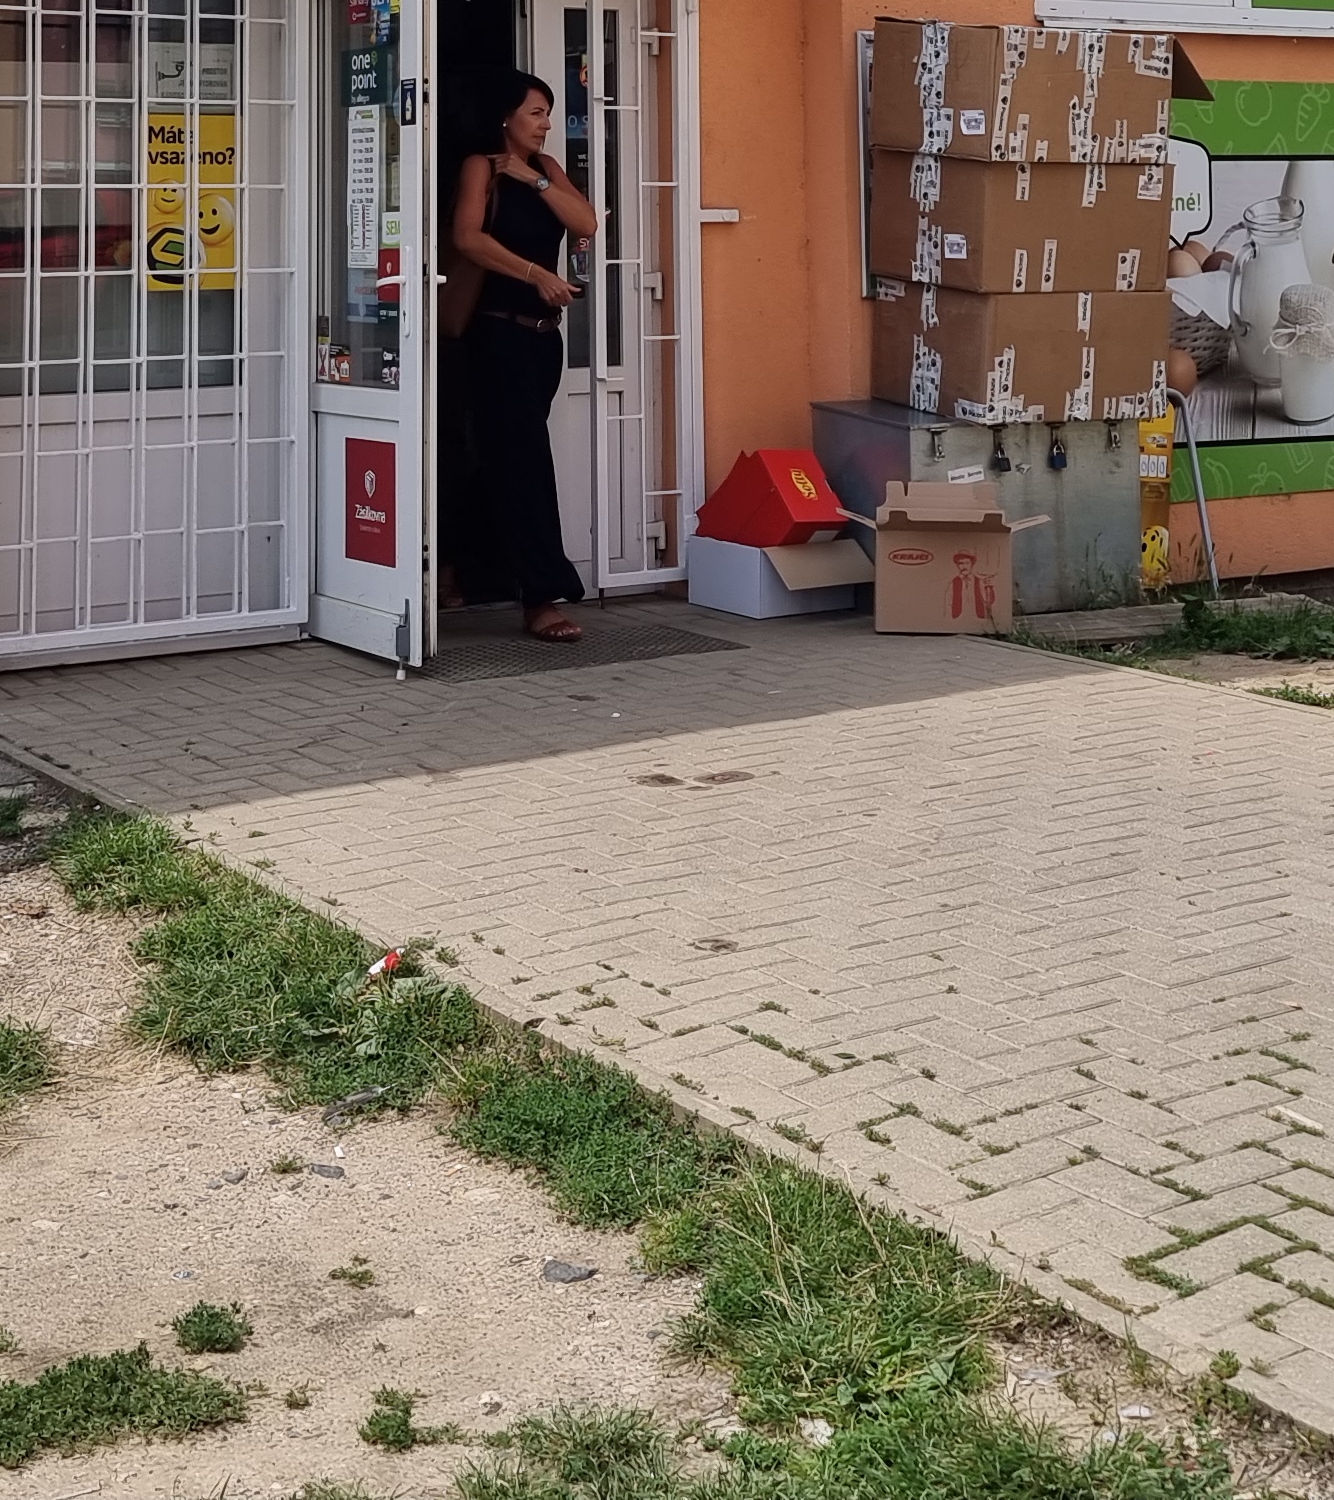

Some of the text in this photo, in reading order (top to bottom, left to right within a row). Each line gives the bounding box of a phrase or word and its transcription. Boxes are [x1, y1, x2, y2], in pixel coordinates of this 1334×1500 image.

[351, 53, 371, 71] one
[351, 69, 378, 92] point
[1171, 192, 1201, 211] né!
